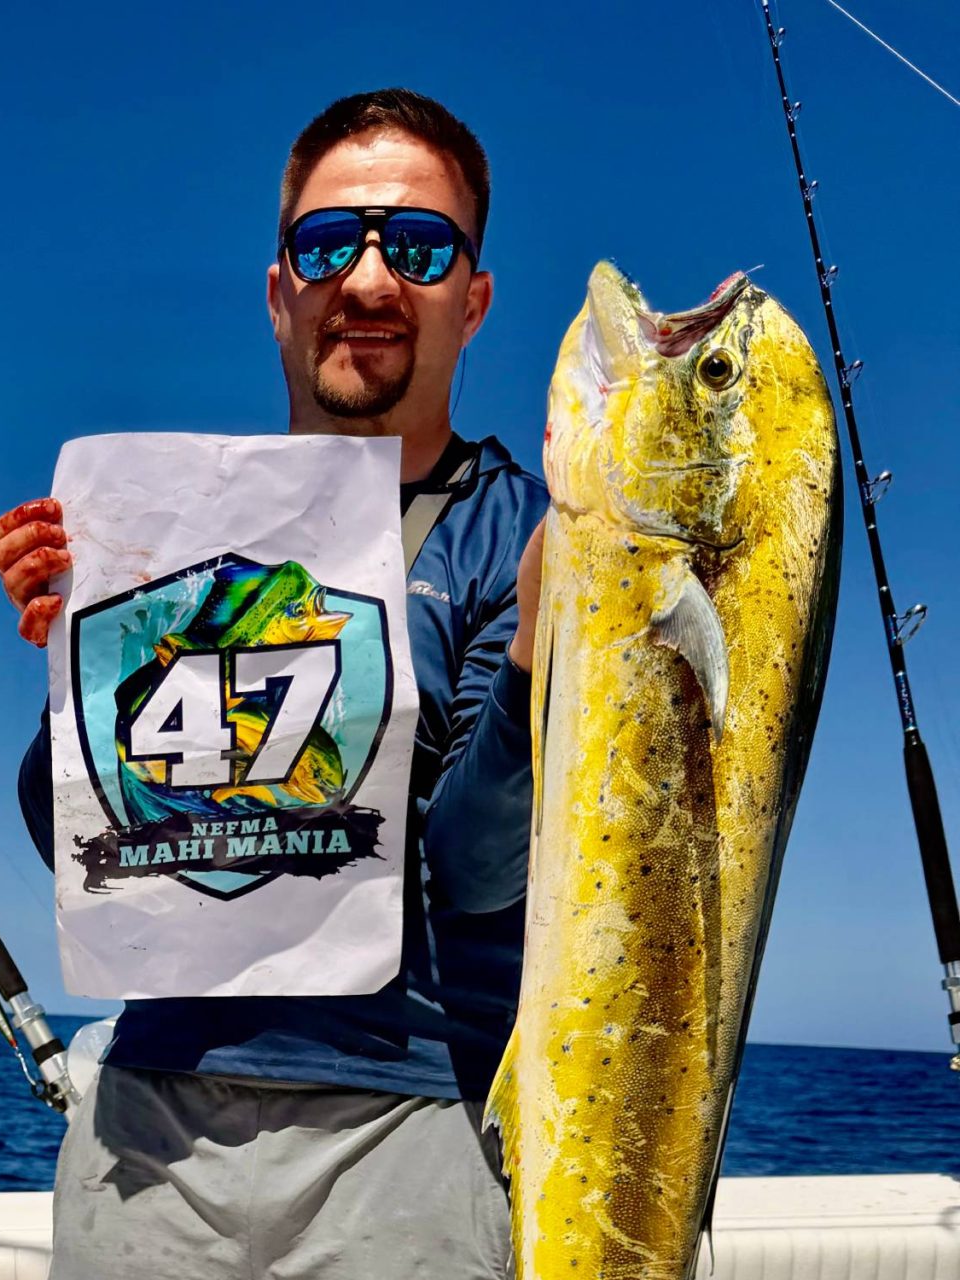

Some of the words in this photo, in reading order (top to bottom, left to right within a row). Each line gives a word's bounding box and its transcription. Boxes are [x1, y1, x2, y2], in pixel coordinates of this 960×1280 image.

[130, 643, 337, 788] 47
[191, 816, 279, 837] NEFMA
[118, 838, 215, 868] MAHI
[225, 829, 352, 858] MANIA
